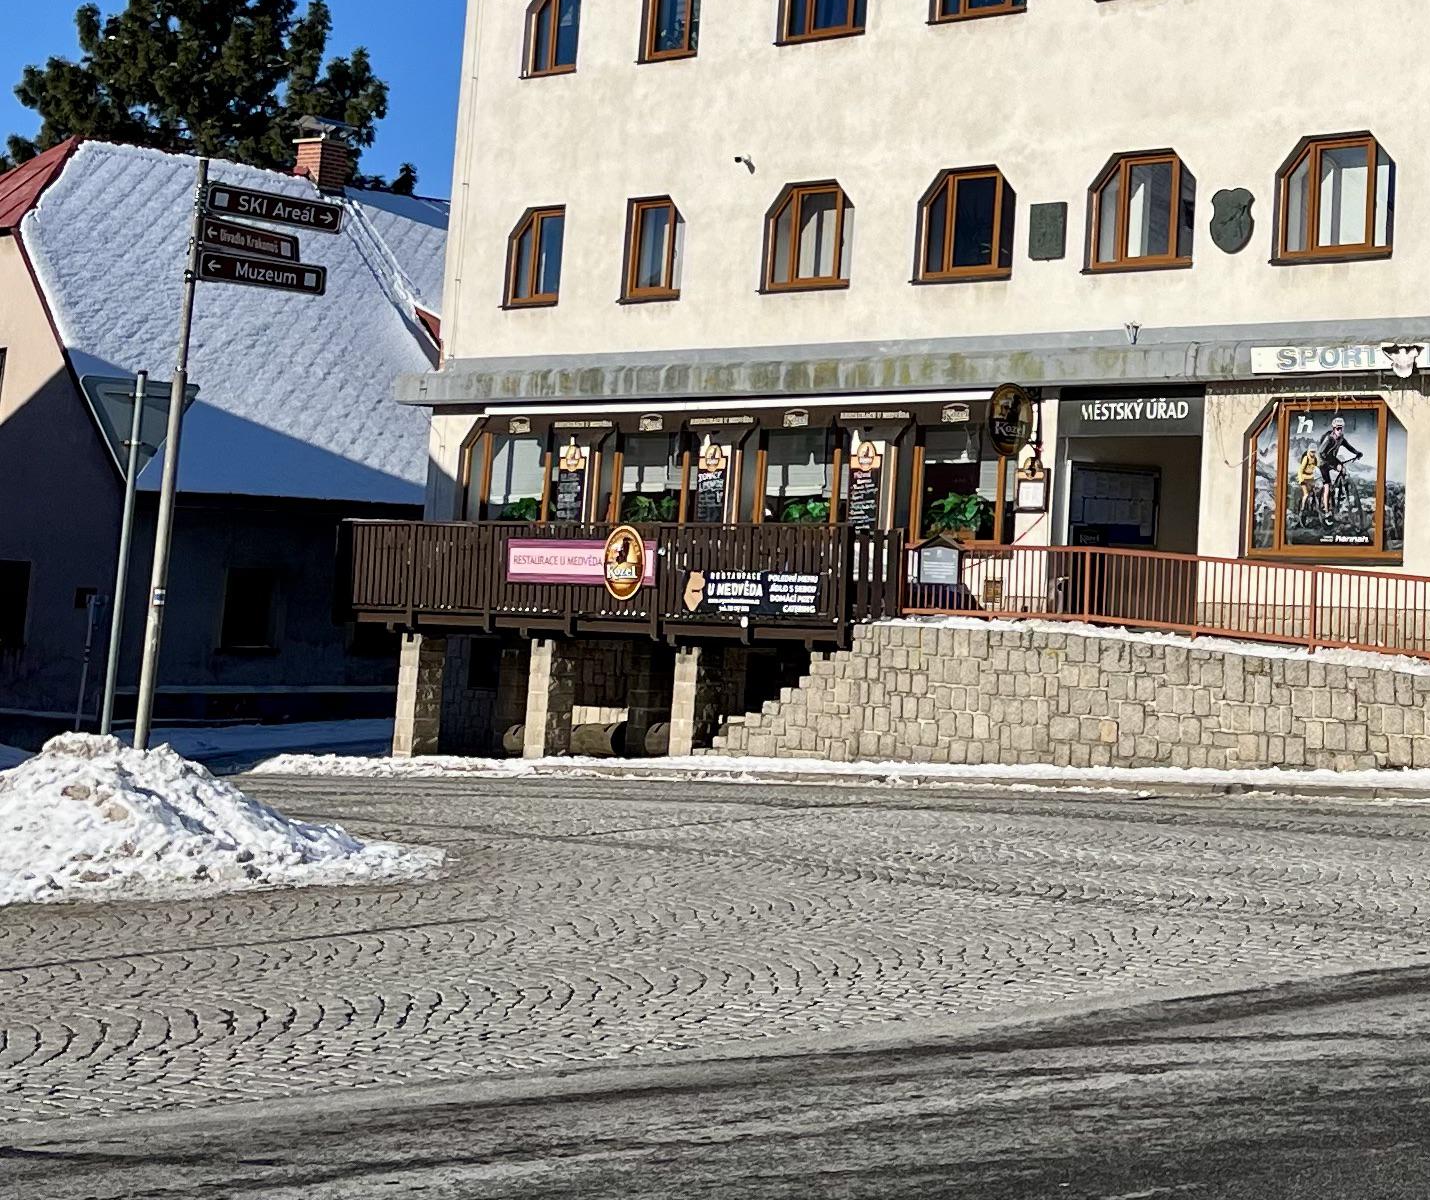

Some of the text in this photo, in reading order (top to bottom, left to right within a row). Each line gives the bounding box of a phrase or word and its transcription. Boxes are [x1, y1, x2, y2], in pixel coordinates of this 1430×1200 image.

[237, 195, 315, 223] SKI Areál
[235, 261, 297, 285] Muzeum
[1276, 347, 1376, 370] SPORT
[1081, 397, 1190, 421] MĚSTSKÝ ÚŘAD
[994, 421, 1026, 438] Kozel
[513, 554, 603, 568] RESTAURACE U MEDVĚDA
[606, 563, 638, 579] Kozel
[710, 571, 762, 580] RESTAURACE
[707, 580, 763, 597] U MEDVĚDA
